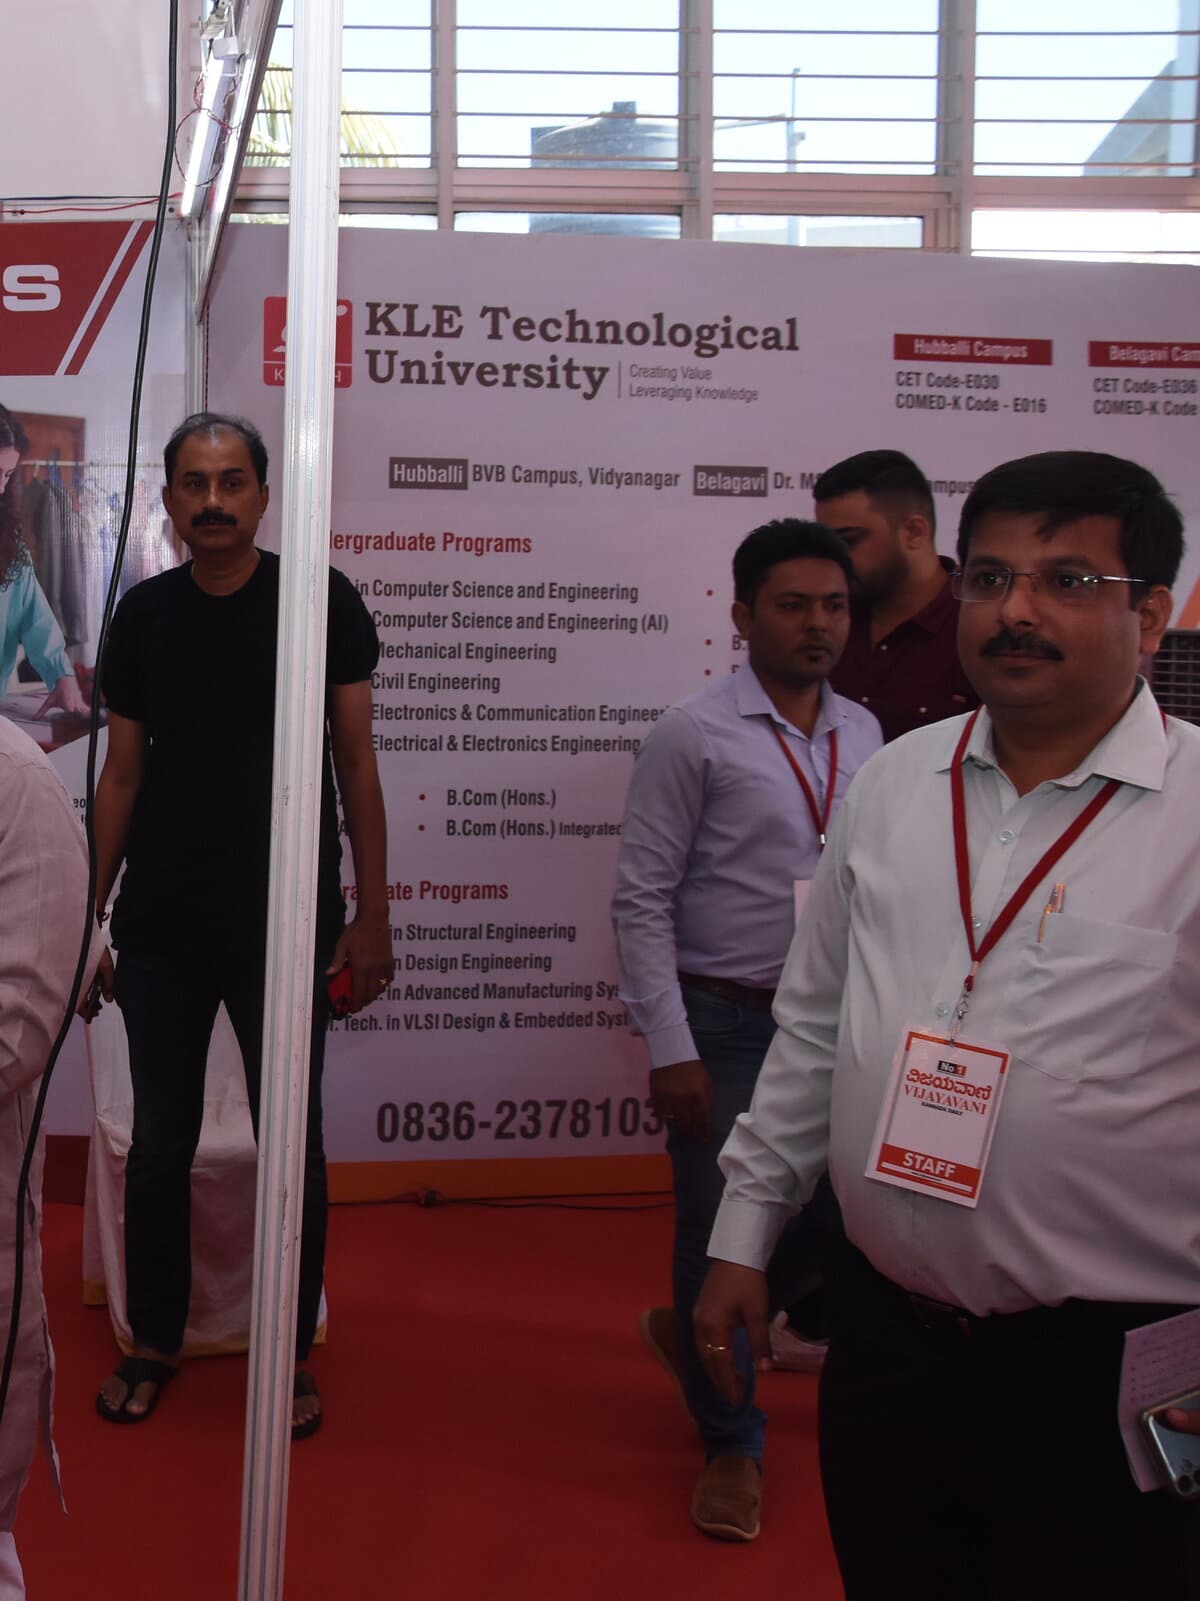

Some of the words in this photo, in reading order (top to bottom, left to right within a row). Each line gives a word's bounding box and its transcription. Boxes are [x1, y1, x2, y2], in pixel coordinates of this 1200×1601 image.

[365, 302, 463, 339] KLE
[480, 305, 800, 358] Technological
[914, 338, 970, 356] Hubballi
[974, 341, 1028, 361] Campus
[1109, 345, 1168, 364] Belagavi
[1171, 347, 1200, 362] Cam
[365, 349, 610, 401] University
[630, 362, 677, 383] Creating
[681, 366, 712, 381] Value
[896, 371, 921, 387] CET
[629, 382, 692, 402] Leveraging
[696, 384, 759, 402] Knowledge
[1093, 378, 1119, 393] CET
[896, 394, 962, 410] COMED-K
[966, 396, 998, 412] Code
[1163, 401, 1198, 416] Code
[393, 463, 464, 484] Hubballi
[472, 464, 506, 483] BVB
[511, 465, 583, 489] Campus,
[588, 466, 680, 490] Vidyanagar
[697, 471, 766, 494] Belagavi
[774, 472, 794, 490] Dr.
[330, 532, 436, 554] ergraduate
[442, 533, 532, 556] Programs
[373, 579, 449, 601] Computer
[453, 581, 514, 598] Science
[518, 582, 545, 599] and
[549, 582, 638, 602] Engineering
[372, 610, 448, 631] Computer
[451, 612, 513, 629] Science
[517, 613, 544, 629] and
[549, 613, 638, 633] Engineering
[642, 615, 668, 634] (AI)
[465, 643, 557, 663] Engineering
[371, 673, 404, 690] Civil
[408, 673, 500, 693] Engineering
[372, 703, 457, 720] Electronics
[460, 704, 473, 721] &
[476, 704, 596, 722] Communication
[372, 734, 443, 752] Electrical
[447, 735, 458, 752] &
[463, 735, 548, 753] Electronics
[552, 735, 640, 756] Engineering
[447, 789, 498, 806] B.Com
[501, 789, 557, 809] (Hons.)
[446, 820, 497, 836] B.Com
[500, 820, 556, 839] (Hons.)
[419, 881, 509, 904] Programs
[389, 925, 402, 941] in
[406, 924, 482, 941] Structural
[486, 923, 576, 943] Engineering
[405, 954, 459, 973] Design
[462, 953, 552, 972] Engineering
[388, 985, 400, 1000] in
[404, 983, 480, 1000] Advanced
[483, 981, 593, 1002] Manufacturing
[344, 1015, 383, 1032] Tech.
[386, 1014, 400, 1031] in
[404, 1013, 439, 1031] VLSI
[443, 1012, 495, 1033] Design
[499, 1012, 511, 1029] &
[514, 1010, 593, 1029] Embedded
[904, 1084, 987, 1115] VIJAYAVANI
[376, 1096, 664, 1144] 0836-2378103
[903, 1151, 957, 1178] STAFF
